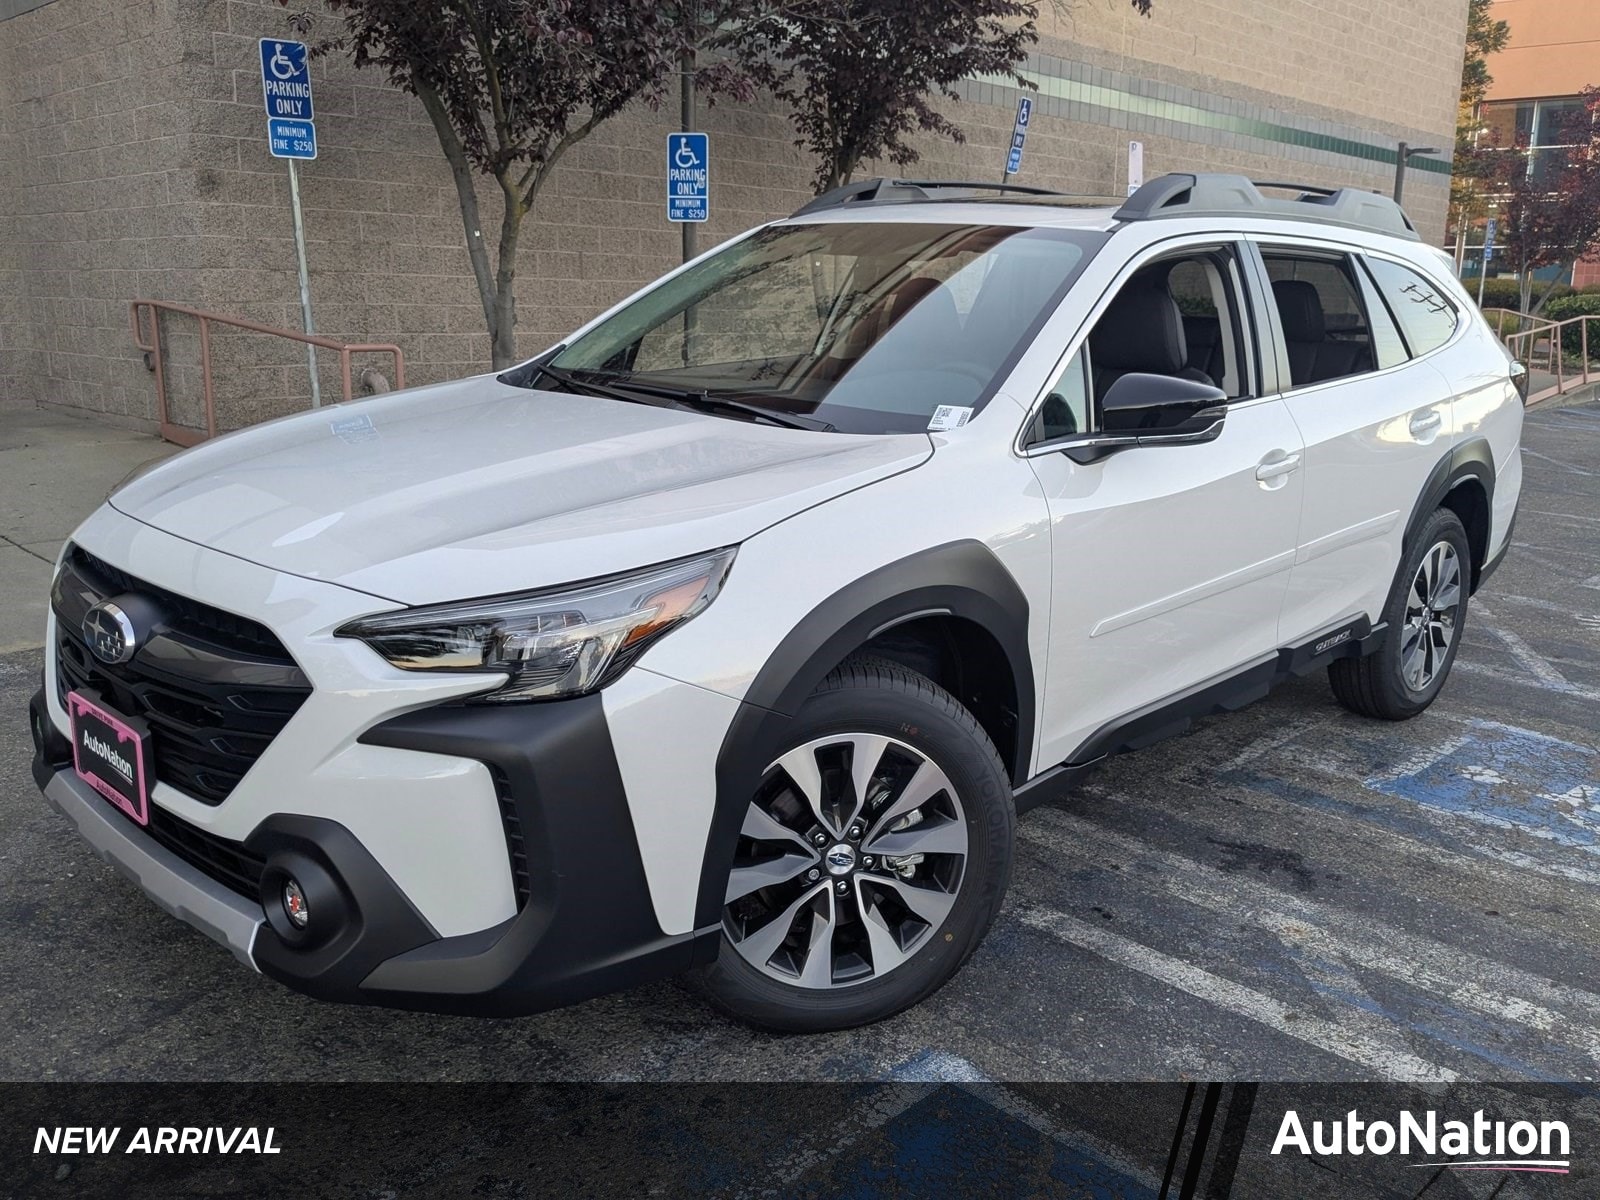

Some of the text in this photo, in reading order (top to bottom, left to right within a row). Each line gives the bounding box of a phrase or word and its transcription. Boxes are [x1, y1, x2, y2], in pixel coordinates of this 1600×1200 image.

[266, 80, 309, 98] PARKING
[276, 99, 302, 115] ONLY
[277, 126, 307, 138] MINIMUM
[273, 139, 313, 152] FINE $250
[670, 168, 706, 181] PARKING
[677, 182, 698, 195] ONLY
[675, 199, 701, 208] MINIMUM
[671, 209, 705, 218] FINE $250
[83, 729, 133, 779] AutoNation
